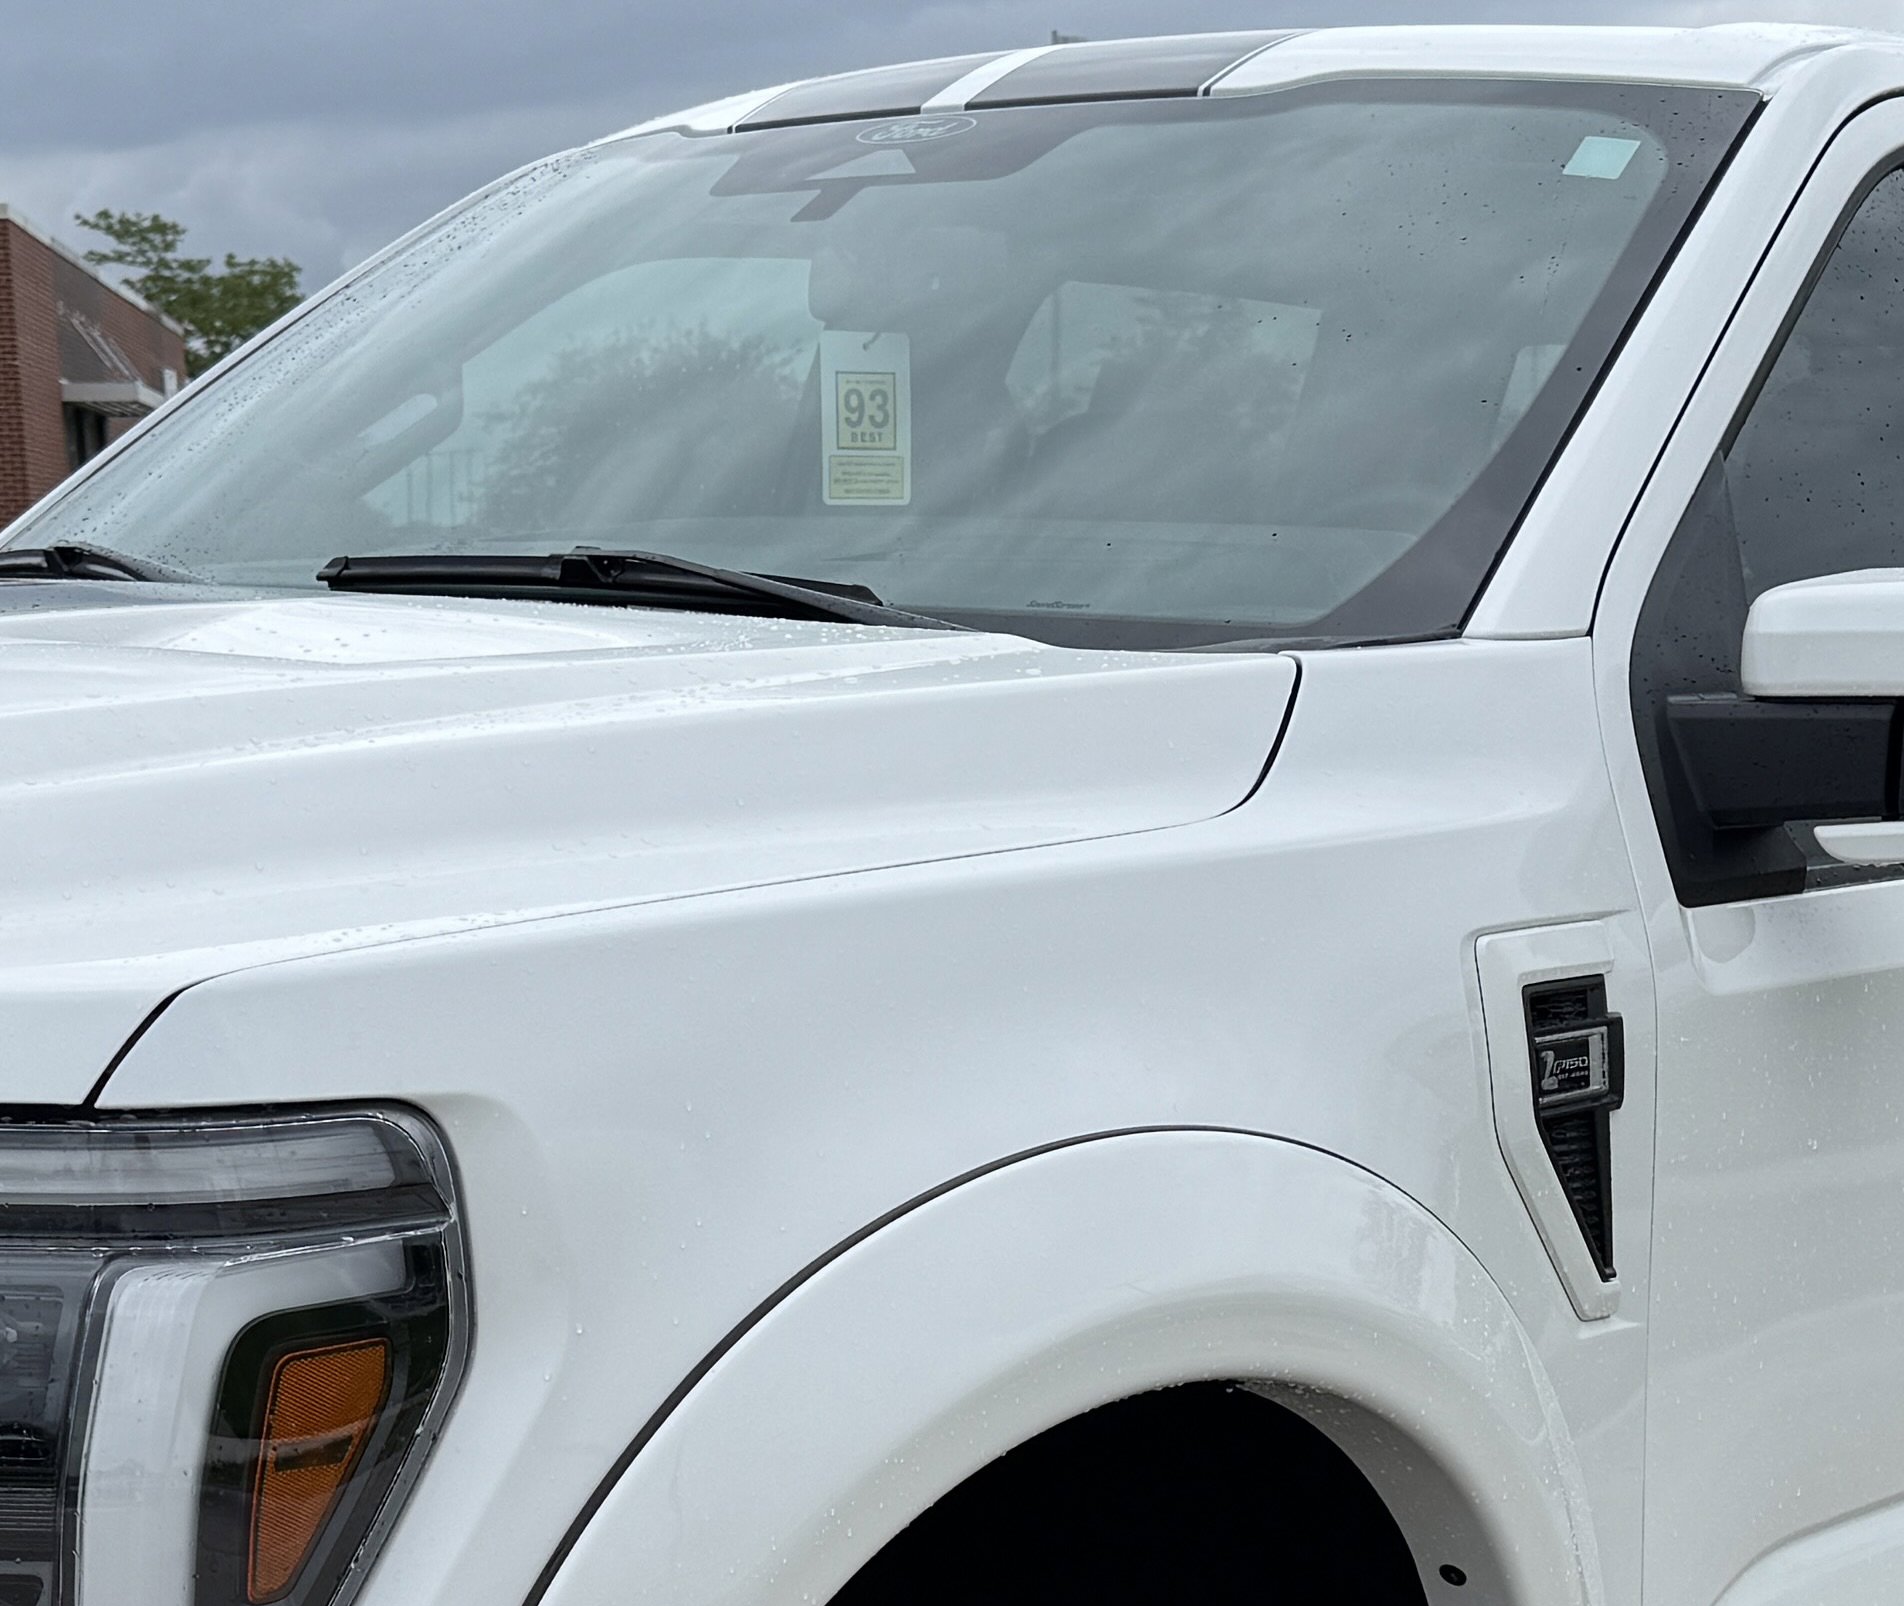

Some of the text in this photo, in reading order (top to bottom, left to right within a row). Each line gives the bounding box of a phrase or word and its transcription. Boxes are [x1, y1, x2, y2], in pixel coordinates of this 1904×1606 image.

[871, 120, 959, 141] Ford
[843, 388, 890, 429] 93
[850, 431, 884, 443] BEST
